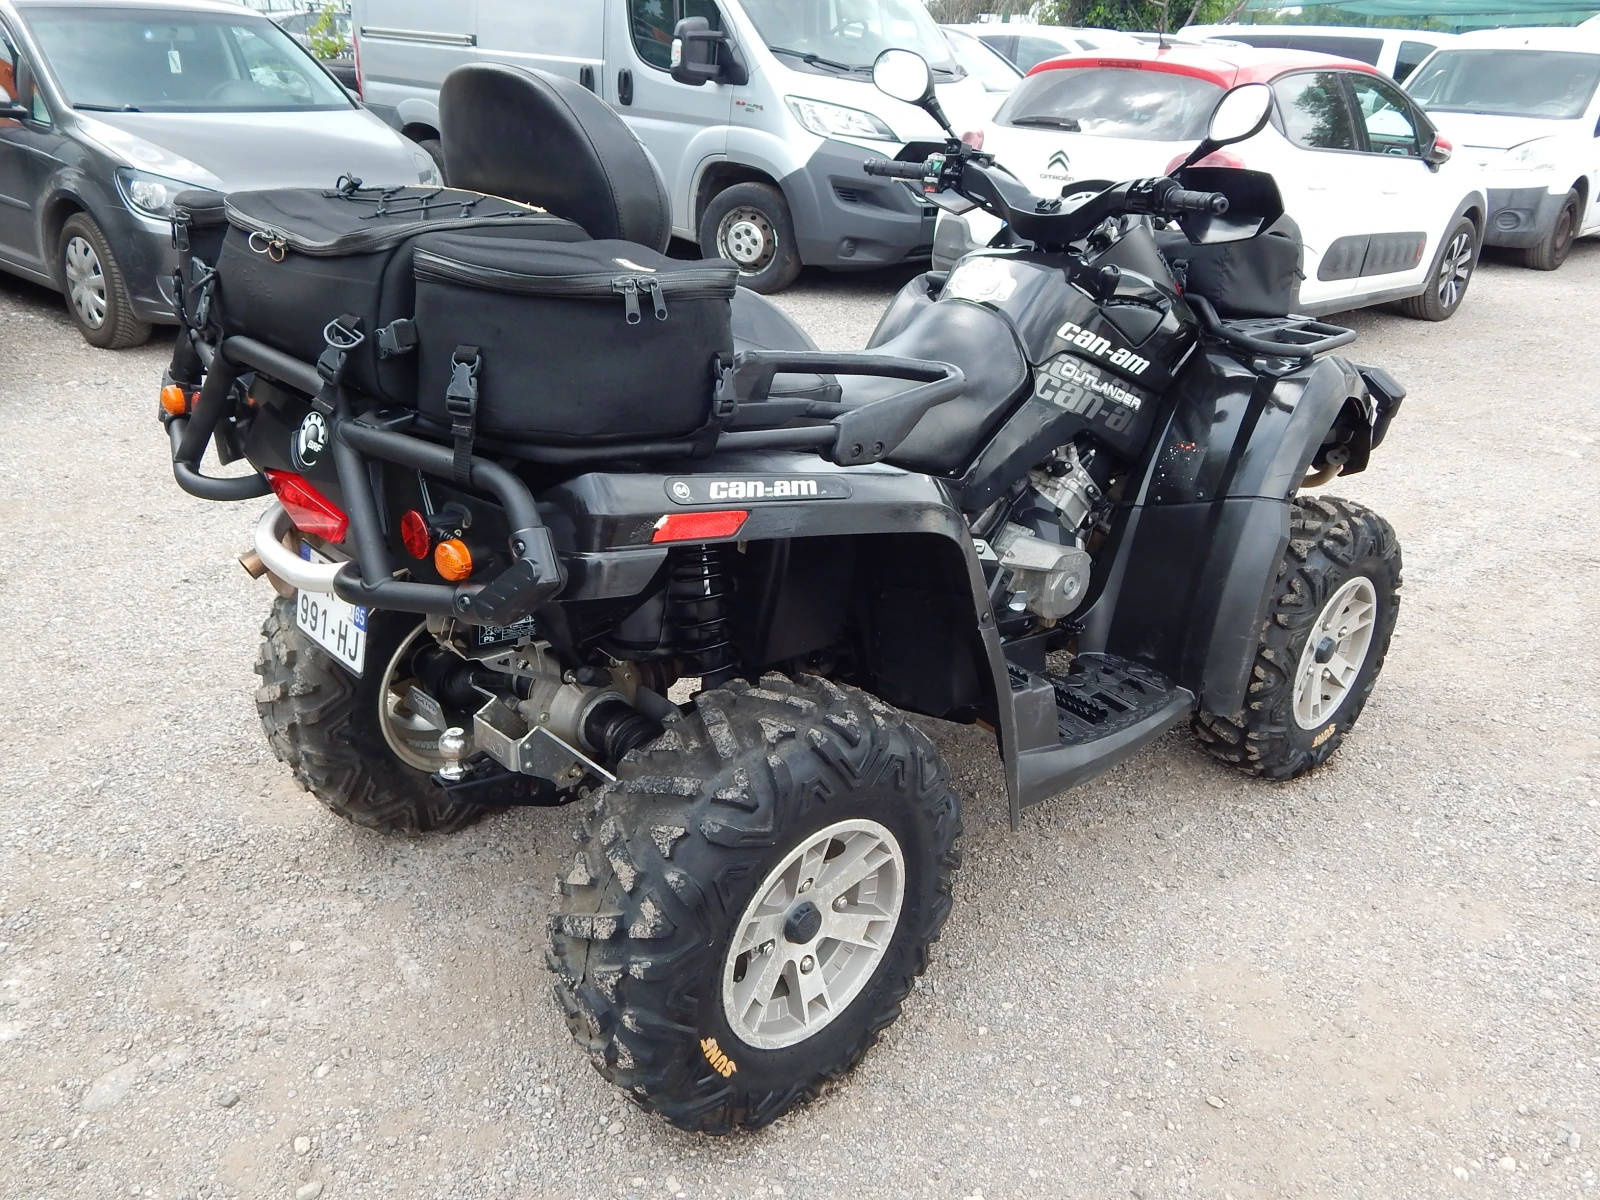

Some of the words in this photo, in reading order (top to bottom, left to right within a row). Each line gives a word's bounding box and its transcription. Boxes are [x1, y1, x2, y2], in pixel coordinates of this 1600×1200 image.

[1056, 321, 1151, 376] can-am
[1060, 362, 1142, 411] OUTLANDER
[709, 479, 818, 500] can-am
[300, 594, 360, 662] 991-HJ
[355, 606, 366, 626] 65
